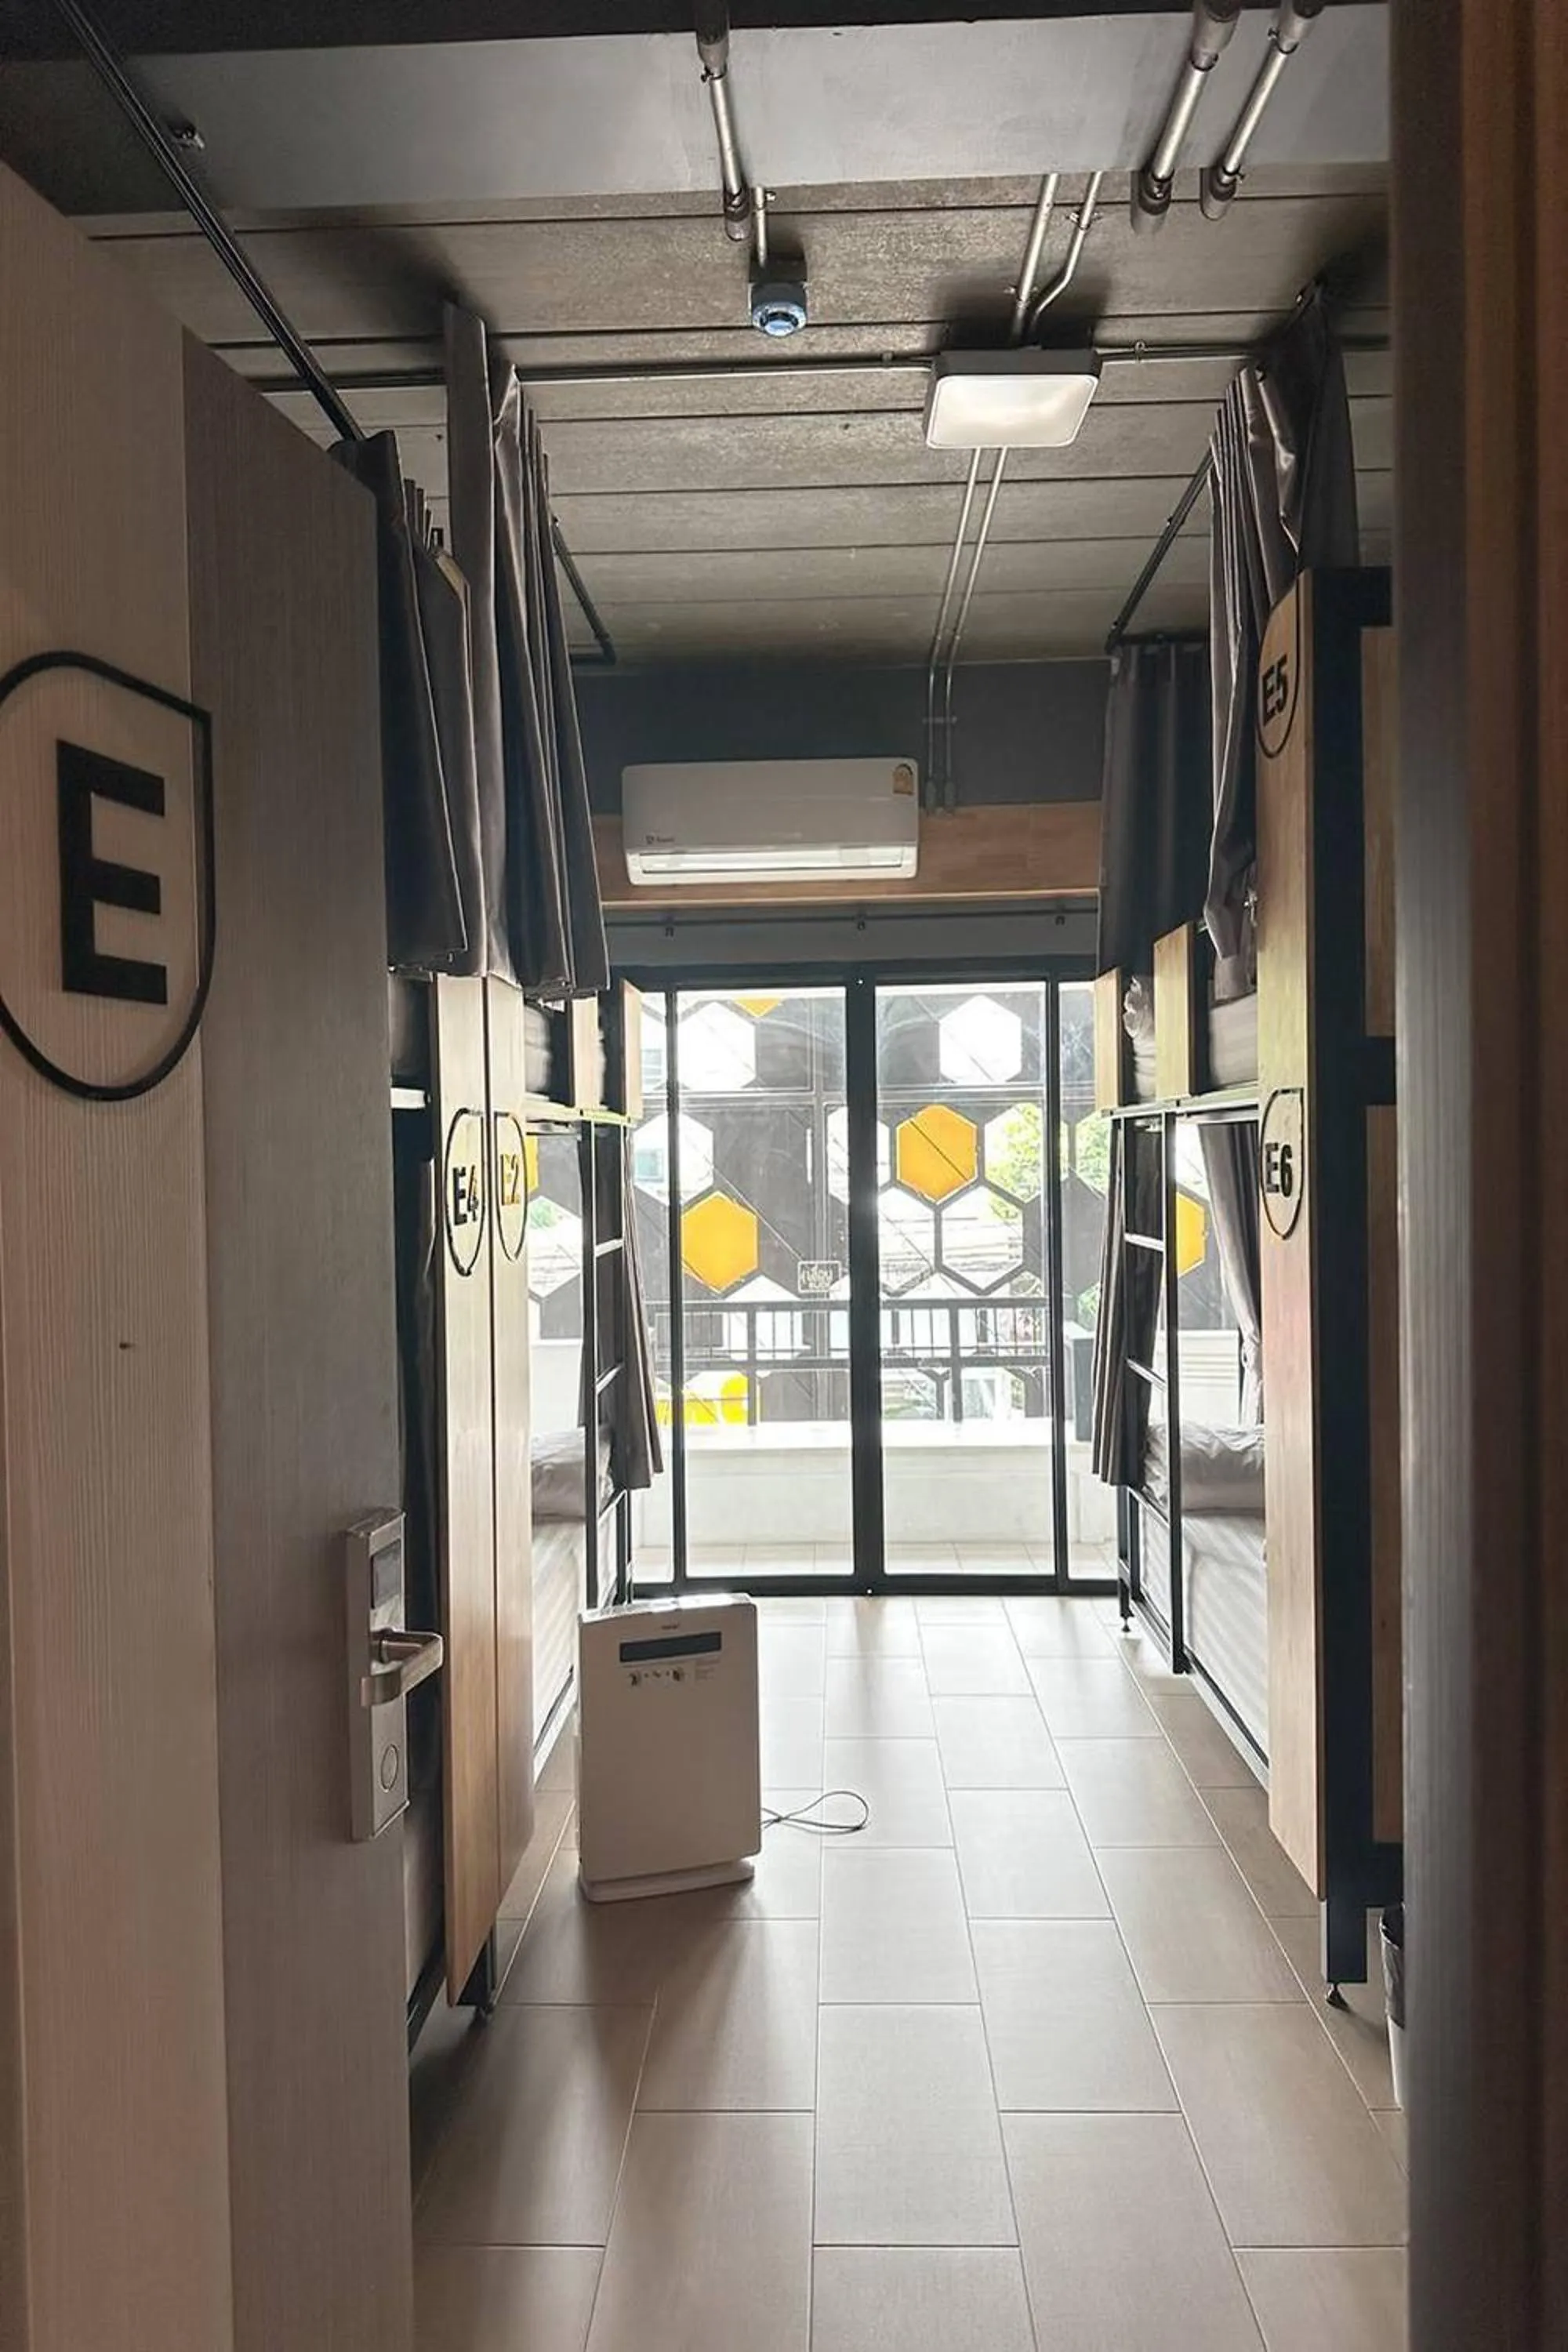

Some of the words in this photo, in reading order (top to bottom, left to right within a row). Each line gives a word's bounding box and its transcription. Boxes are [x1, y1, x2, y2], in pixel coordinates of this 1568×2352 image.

[1262, 653, 1287, 727] E5
[56, 739, 168, 1004] E
[452, 1164, 479, 1226] E4
[1265, 1142, 1293, 1197] E6
